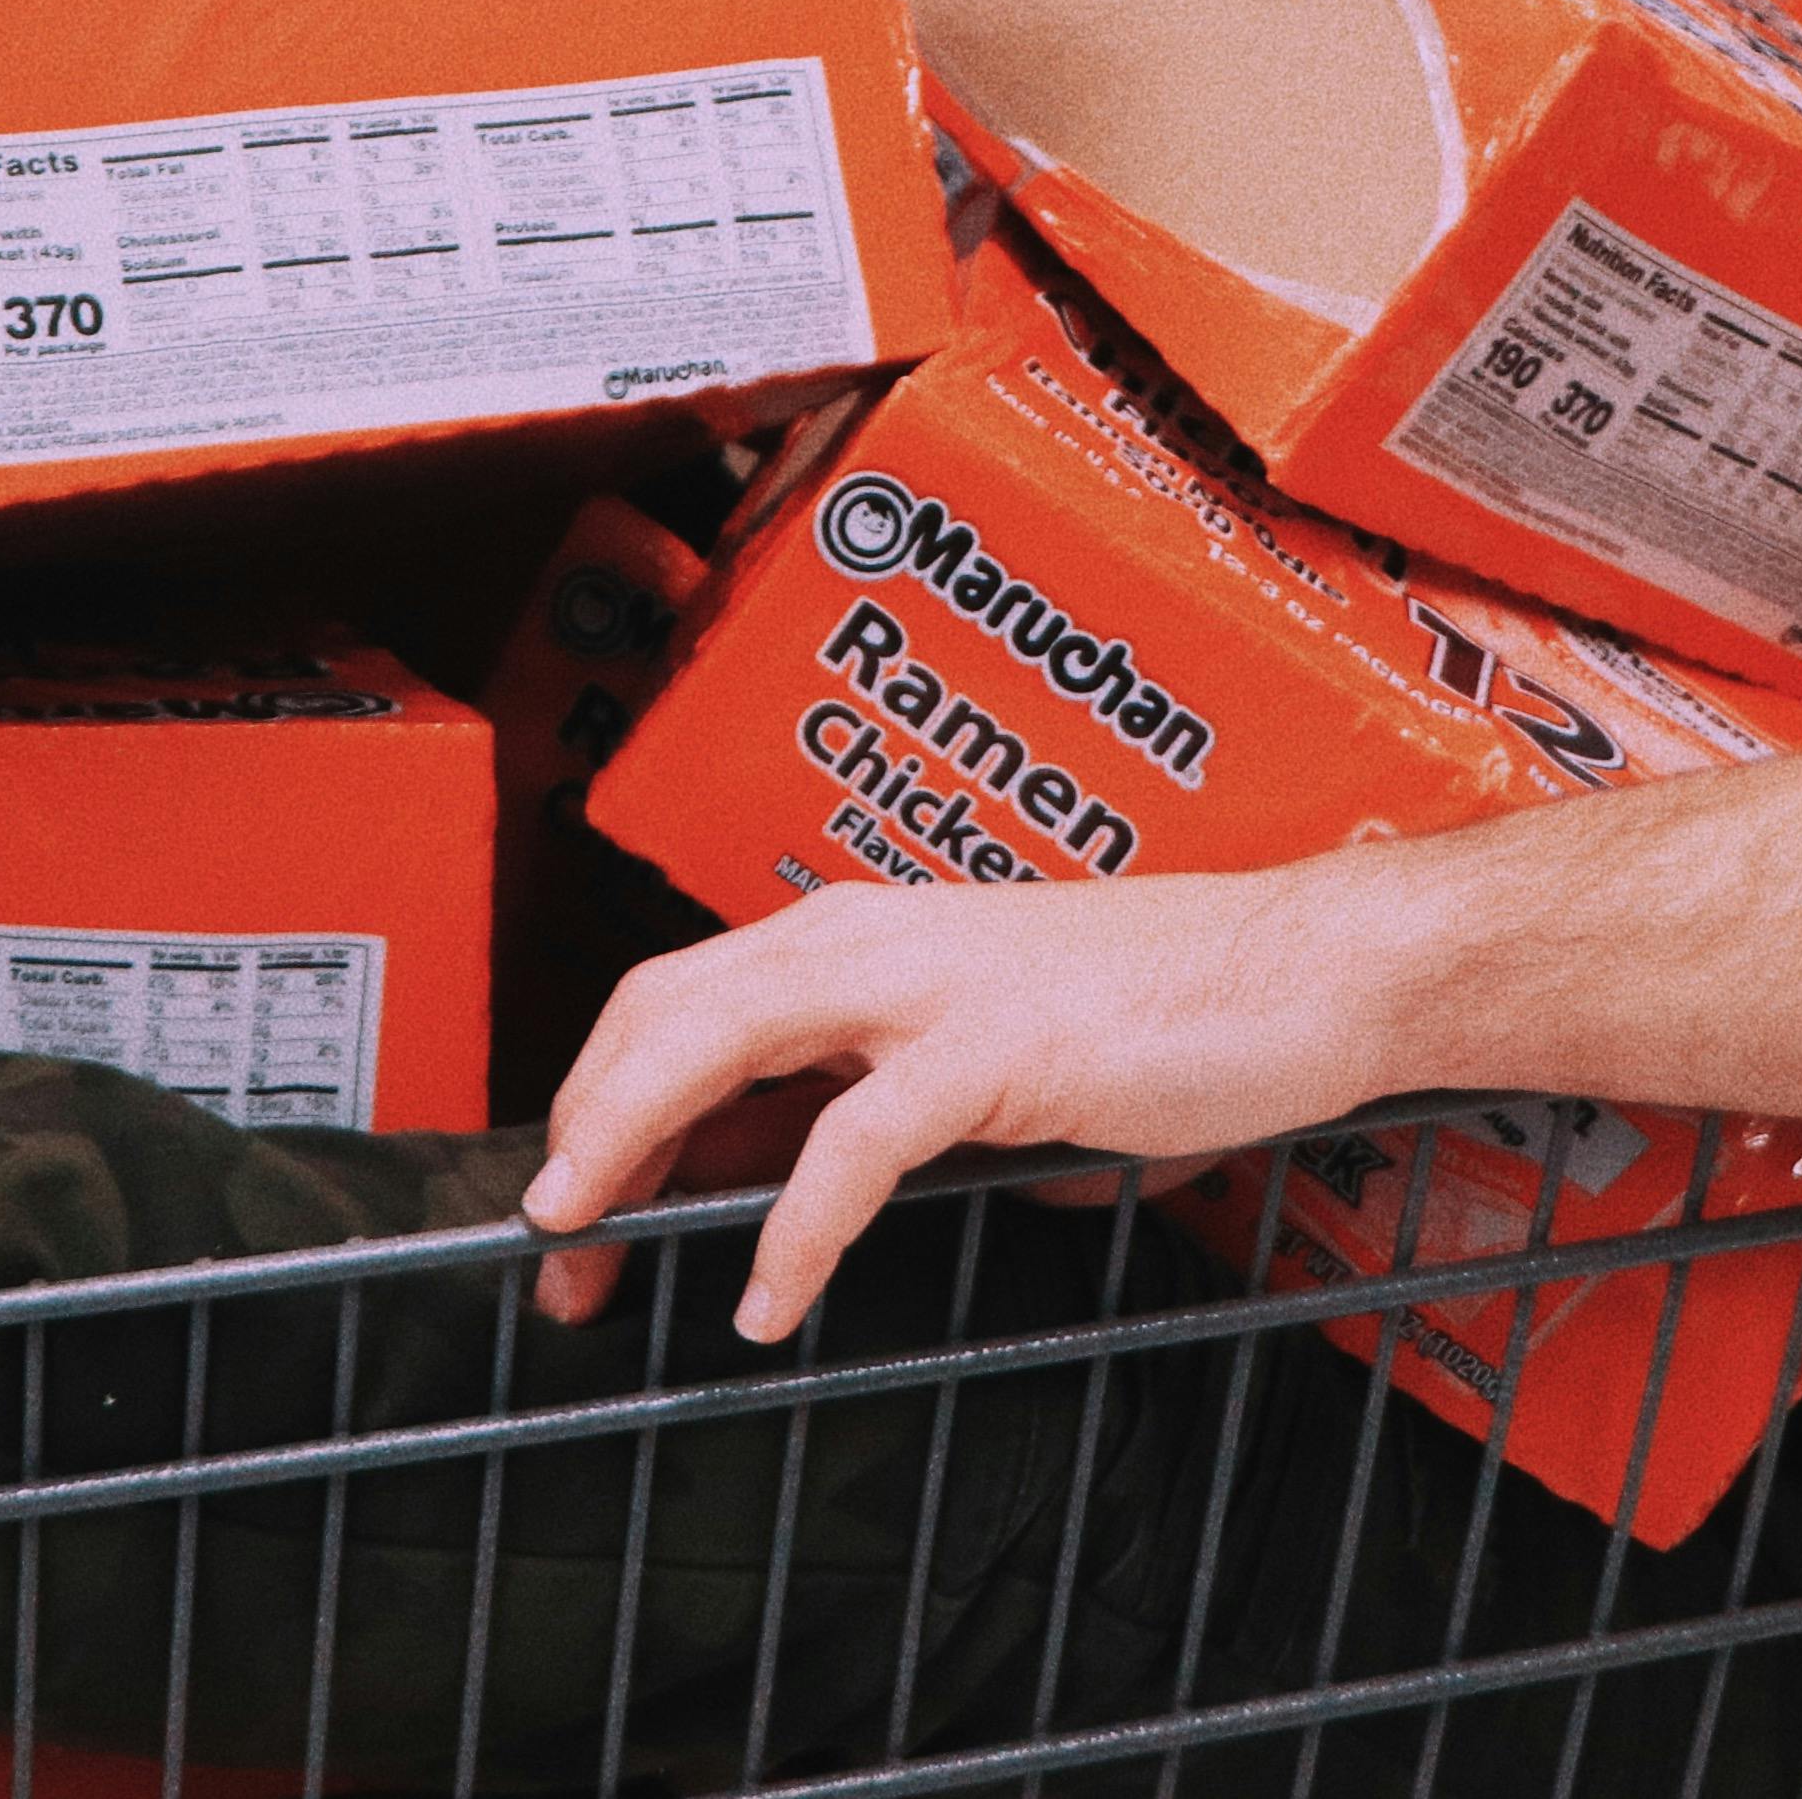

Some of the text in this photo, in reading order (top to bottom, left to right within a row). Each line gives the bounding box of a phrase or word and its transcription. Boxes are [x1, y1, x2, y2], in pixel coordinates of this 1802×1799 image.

[478, 133, 521, 145] Total
[117, 227, 221, 249] Cholesterol
[495, 221, 557, 234] Protein
[1567, 222, 1697, 313] Nutrition Facts
[3, 292, 104, 340] 370
[624, 358, 727, 386] Maruchan
[1483, 336, 1614, 435] 190 370
[906, 498, 1210, 776] Maruchan
[1405, 595, 1628, 792] 12
[823, 601, 1136, 874] Ramen
[11, 967, 54, 987] Total
